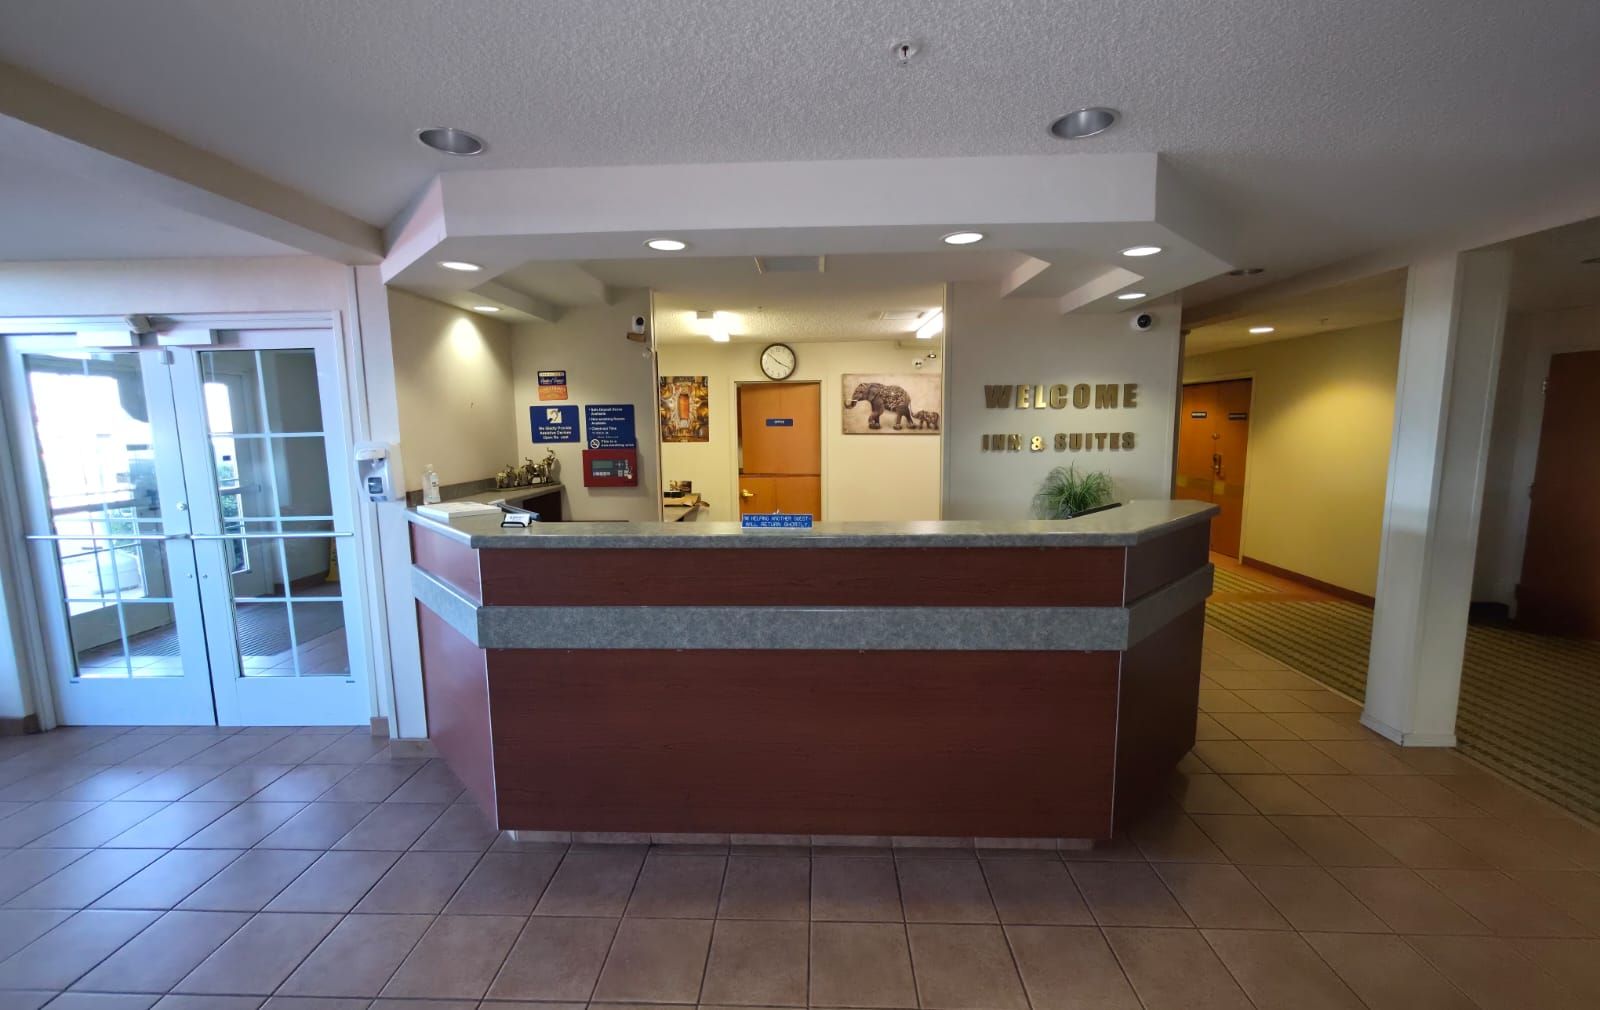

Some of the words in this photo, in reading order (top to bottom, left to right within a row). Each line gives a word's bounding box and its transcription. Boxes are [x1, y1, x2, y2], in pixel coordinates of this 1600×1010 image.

[984, 383, 1138, 409] WELCOME
[982, 434, 1022, 451] INN
[1031, 434, 1045, 452] &
[1054, 431, 1135, 452] SUITES
